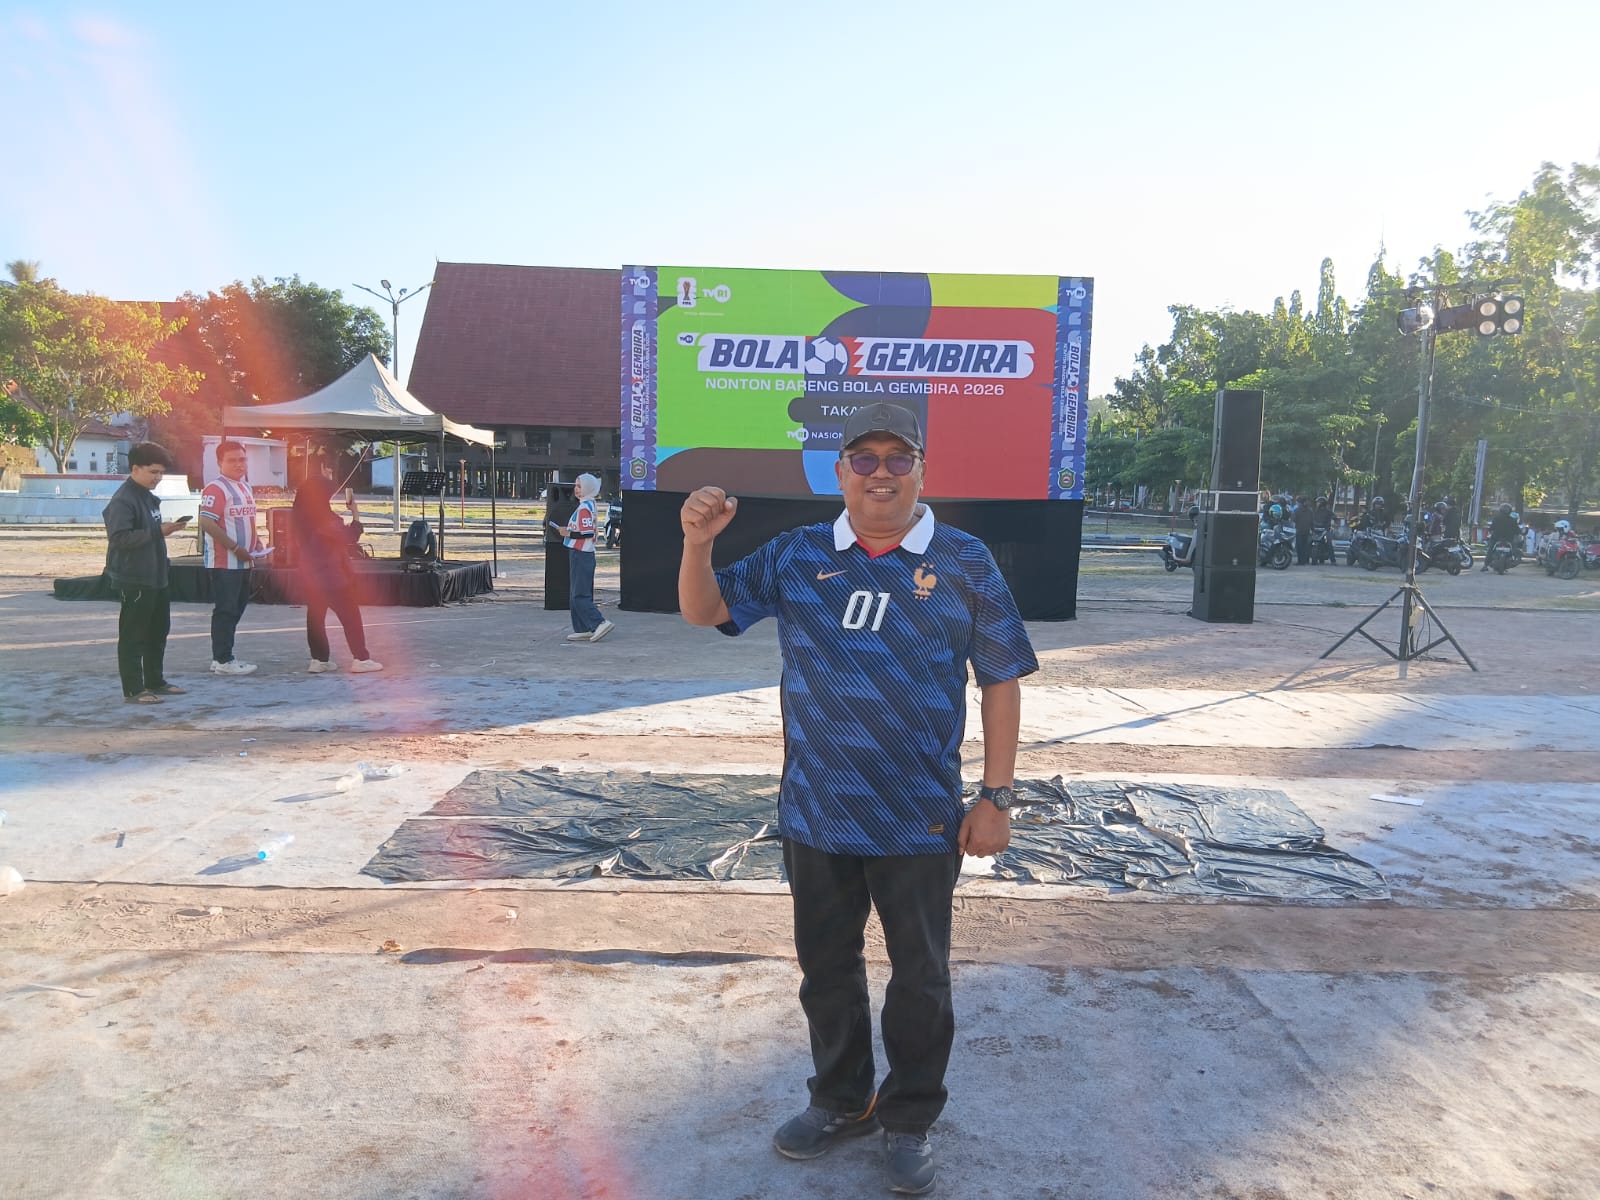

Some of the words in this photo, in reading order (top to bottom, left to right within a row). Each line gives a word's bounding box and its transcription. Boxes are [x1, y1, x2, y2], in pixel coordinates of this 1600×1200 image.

[633, 329, 642, 376] GEMBIRA
[709, 338, 799, 369] BOLA
[865, 342, 1018, 374] GEMBIRA
[1070, 345, 1080, 373] BOLA
[705, 377, 771, 391] NONTON
[775, 379, 839, 392] BARENG
[843, 381, 884, 393] BOLA
[888, 382, 959, 395] GEMBIRA
[963, 384, 1005, 396] 2026
[633, 396, 642, 423] BOLA
[821, 405, 863, 416] TAKA
[1066, 392, 1077, 439] GEMBIRA
[842, 590, 891, 632] 01
